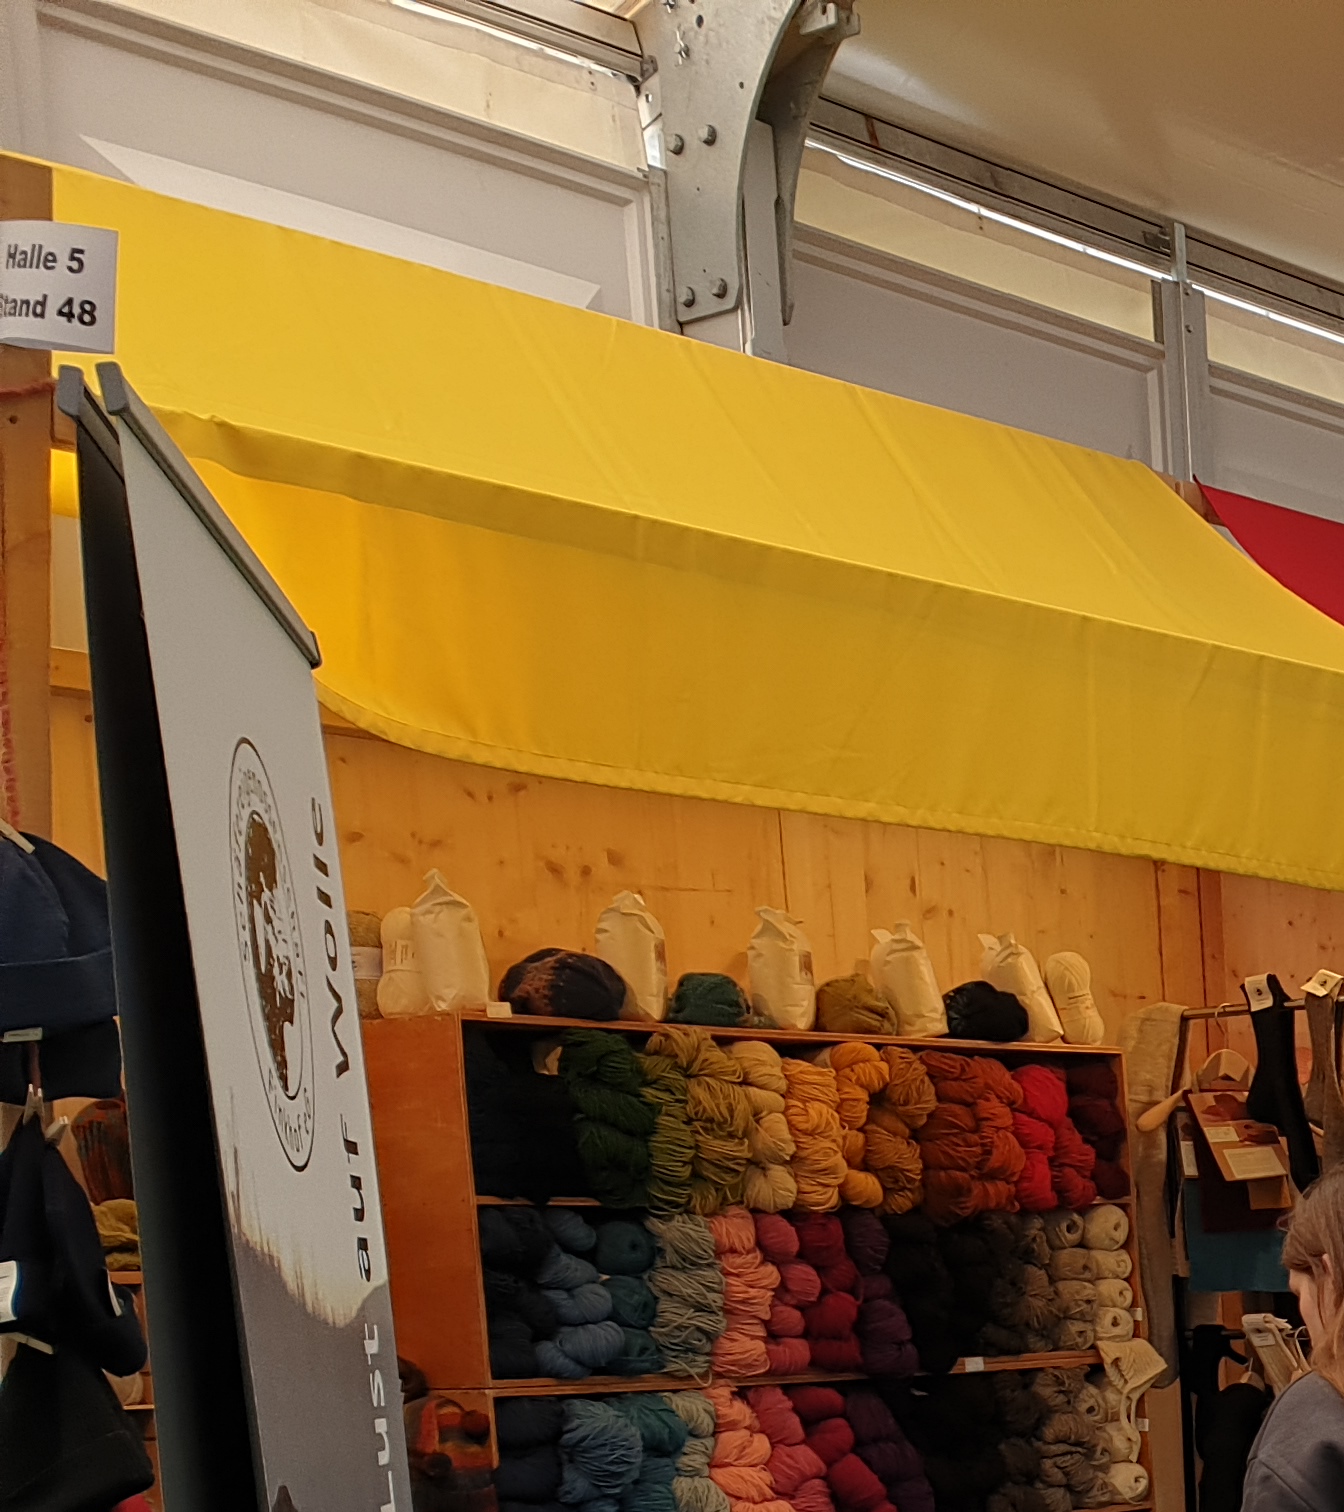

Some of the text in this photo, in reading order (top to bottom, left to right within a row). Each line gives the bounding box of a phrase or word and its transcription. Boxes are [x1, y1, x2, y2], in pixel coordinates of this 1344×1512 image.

[6, 243, 86, 274] Halle 5
[56, 296, 97, 327] 48
[308, 797, 350, 1078] Wolle
[338, 1124, 374, 1283] auf
